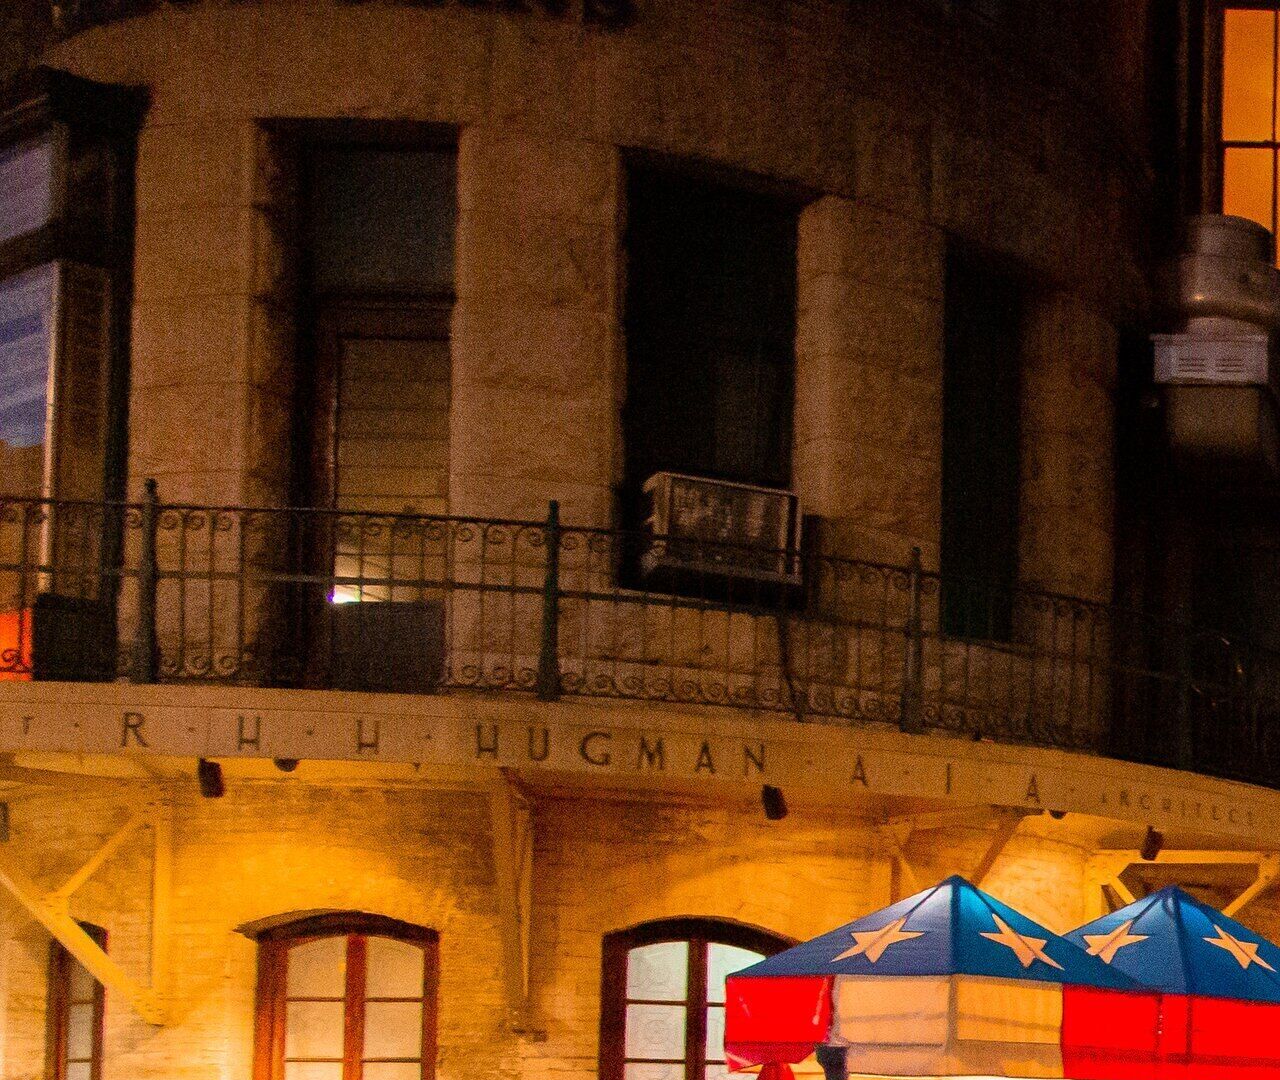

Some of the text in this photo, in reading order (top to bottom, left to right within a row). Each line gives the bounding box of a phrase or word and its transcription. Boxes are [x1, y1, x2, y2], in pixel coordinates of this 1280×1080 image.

[119, 711, 150, 749] R
[236, 714, 262, 751] H
[356, 719, 381, 757] H
[475, 723, 767, 776] HUGMAN
[850, 755, 870, 788] A
[1025, 773, 1042, 804] A
